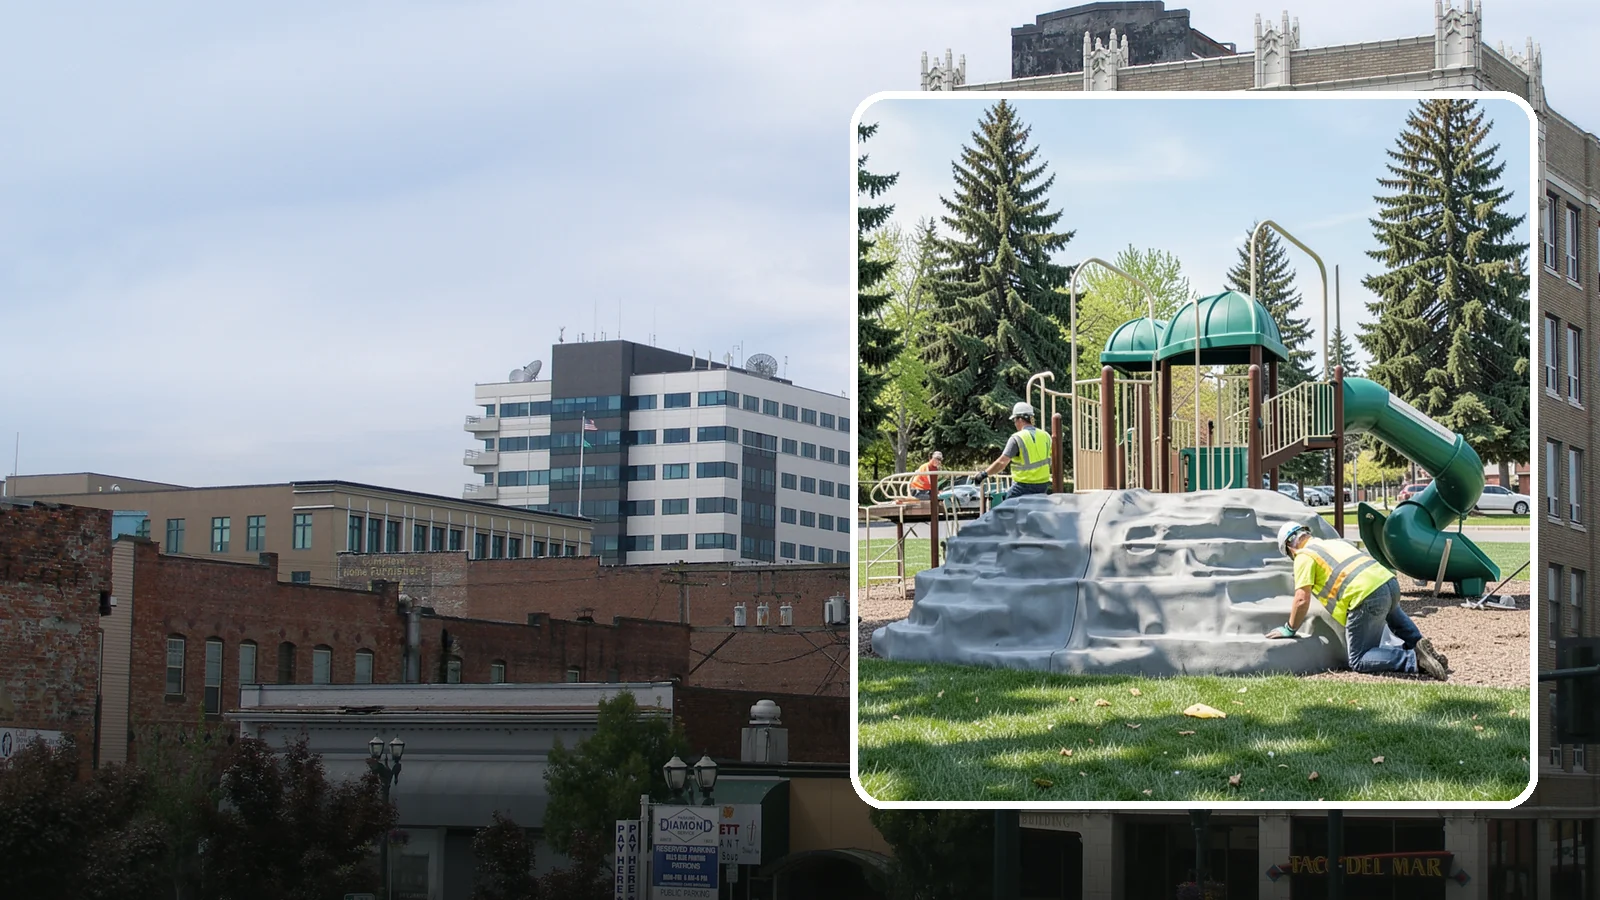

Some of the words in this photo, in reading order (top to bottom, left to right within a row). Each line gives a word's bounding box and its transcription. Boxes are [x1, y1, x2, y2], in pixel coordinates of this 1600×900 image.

[343, 567, 368, 577] Home
[370, 566, 427, 577] Furnishers
[660, 818, 713, 832] DIAMOND
[1021, 815, 1069, 828] BUILDING
[617, 825, 625, 852] PAY
[628, 824, 636, 850] PAY
[656, 845, 688, 853] RESERVED
[689, 846, 716, 854] PARKING
[721, 852, 739, 861] Soup
[671, 862, 701, 870] PATRONS
[1346, 856, 1384, 875] DEL
[1392, 857, 1442, 877] MAR
[617, 856, 625, 893] HERE
[627, 855, 636, 893] HERE
[660, 888, 682, 897] PUBLIC
[683, 889, 710, 898] PARKING
